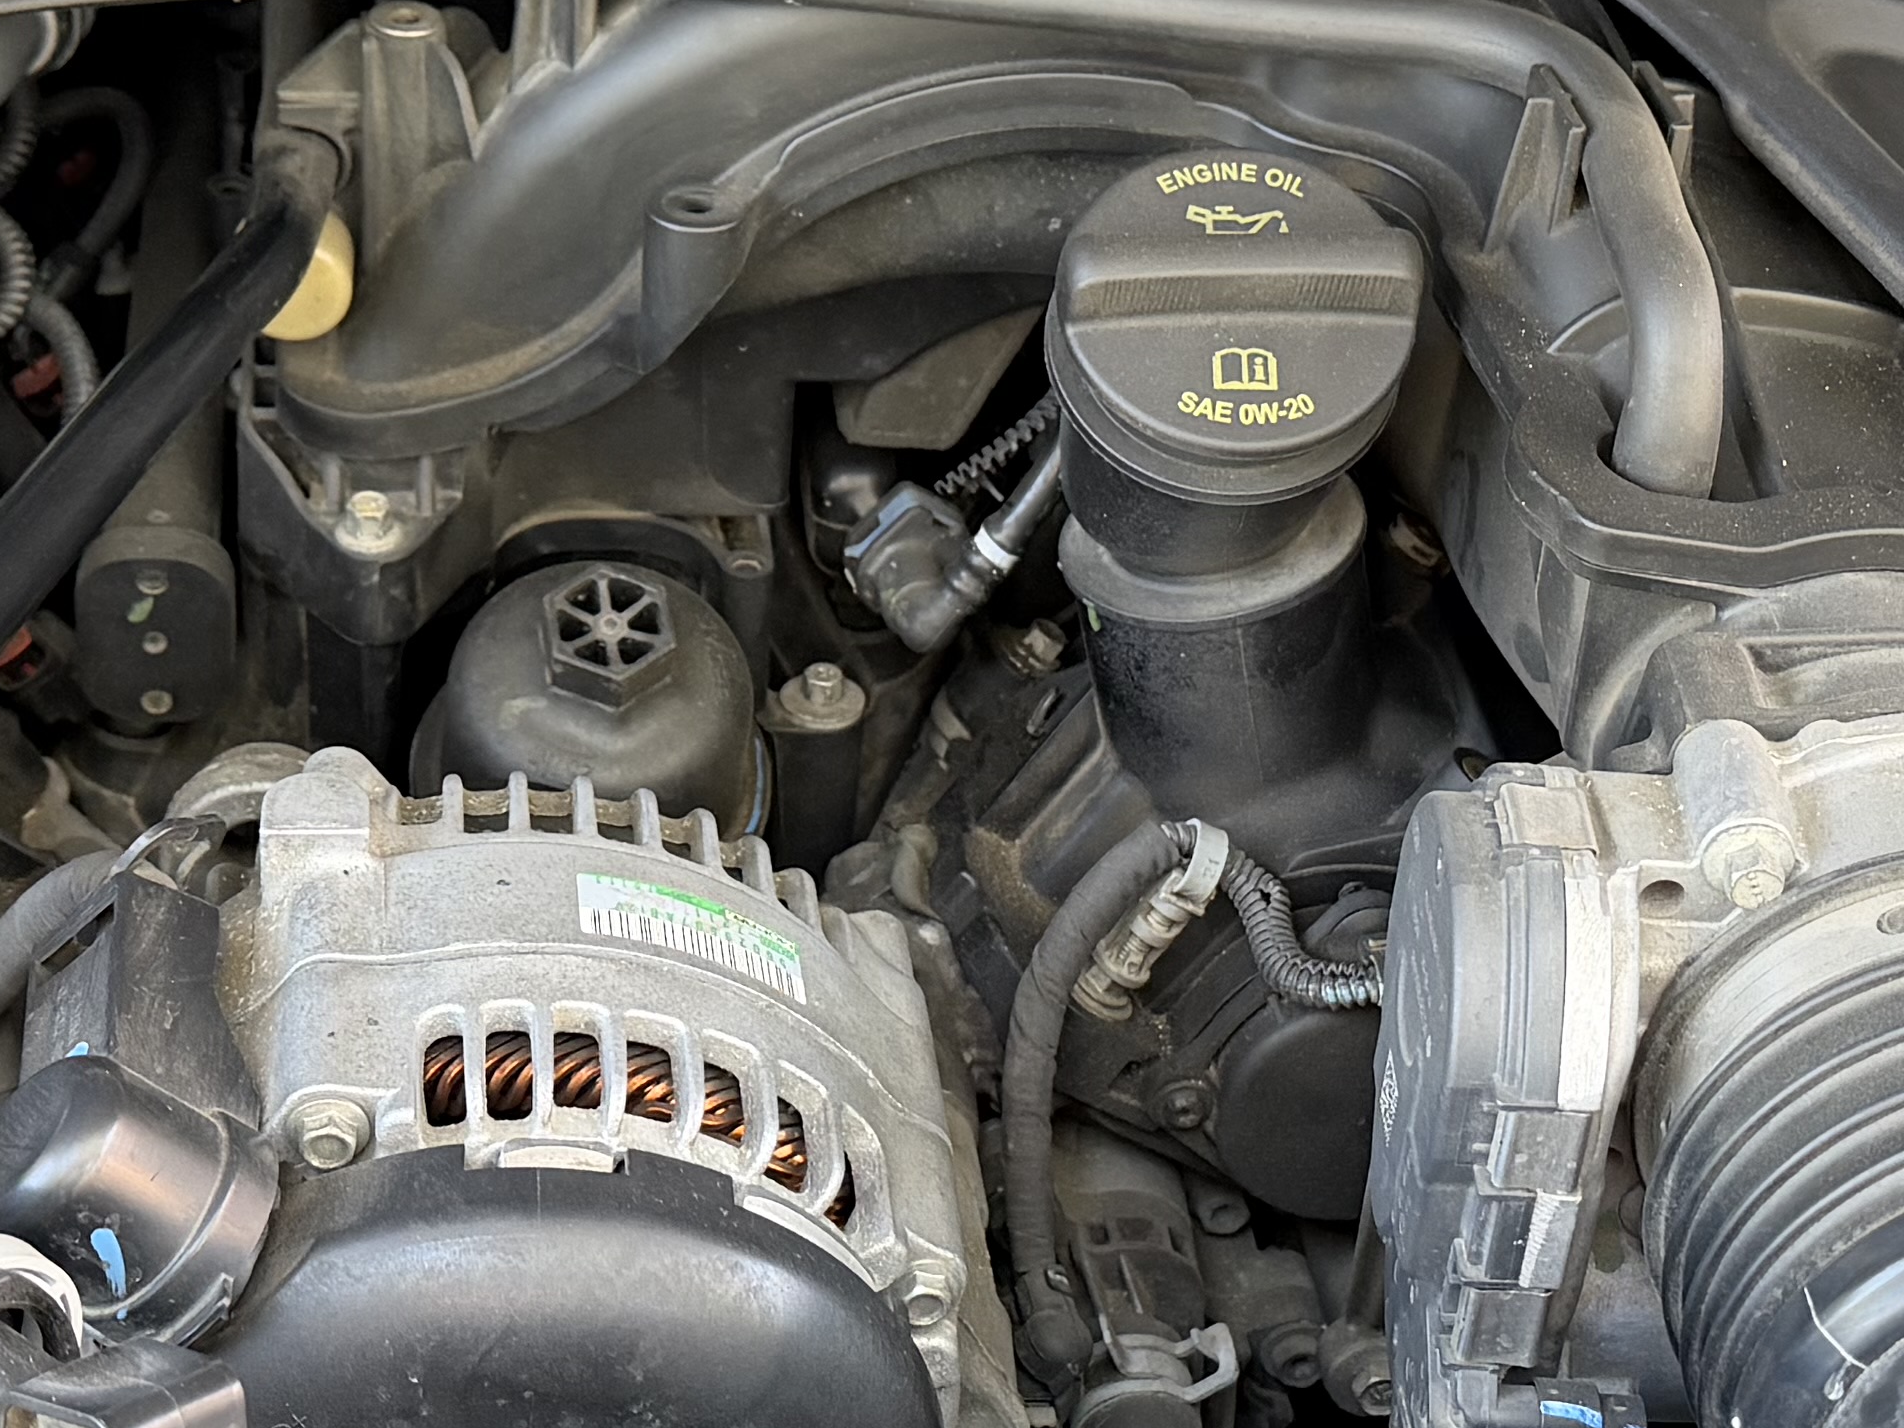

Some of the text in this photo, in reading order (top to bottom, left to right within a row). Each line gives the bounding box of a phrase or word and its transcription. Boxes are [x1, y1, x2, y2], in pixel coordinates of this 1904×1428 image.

[1156, 162, 1304, 198] ENGINE OIL
[1177, 391, 1315, 425] SAE 0W-20
